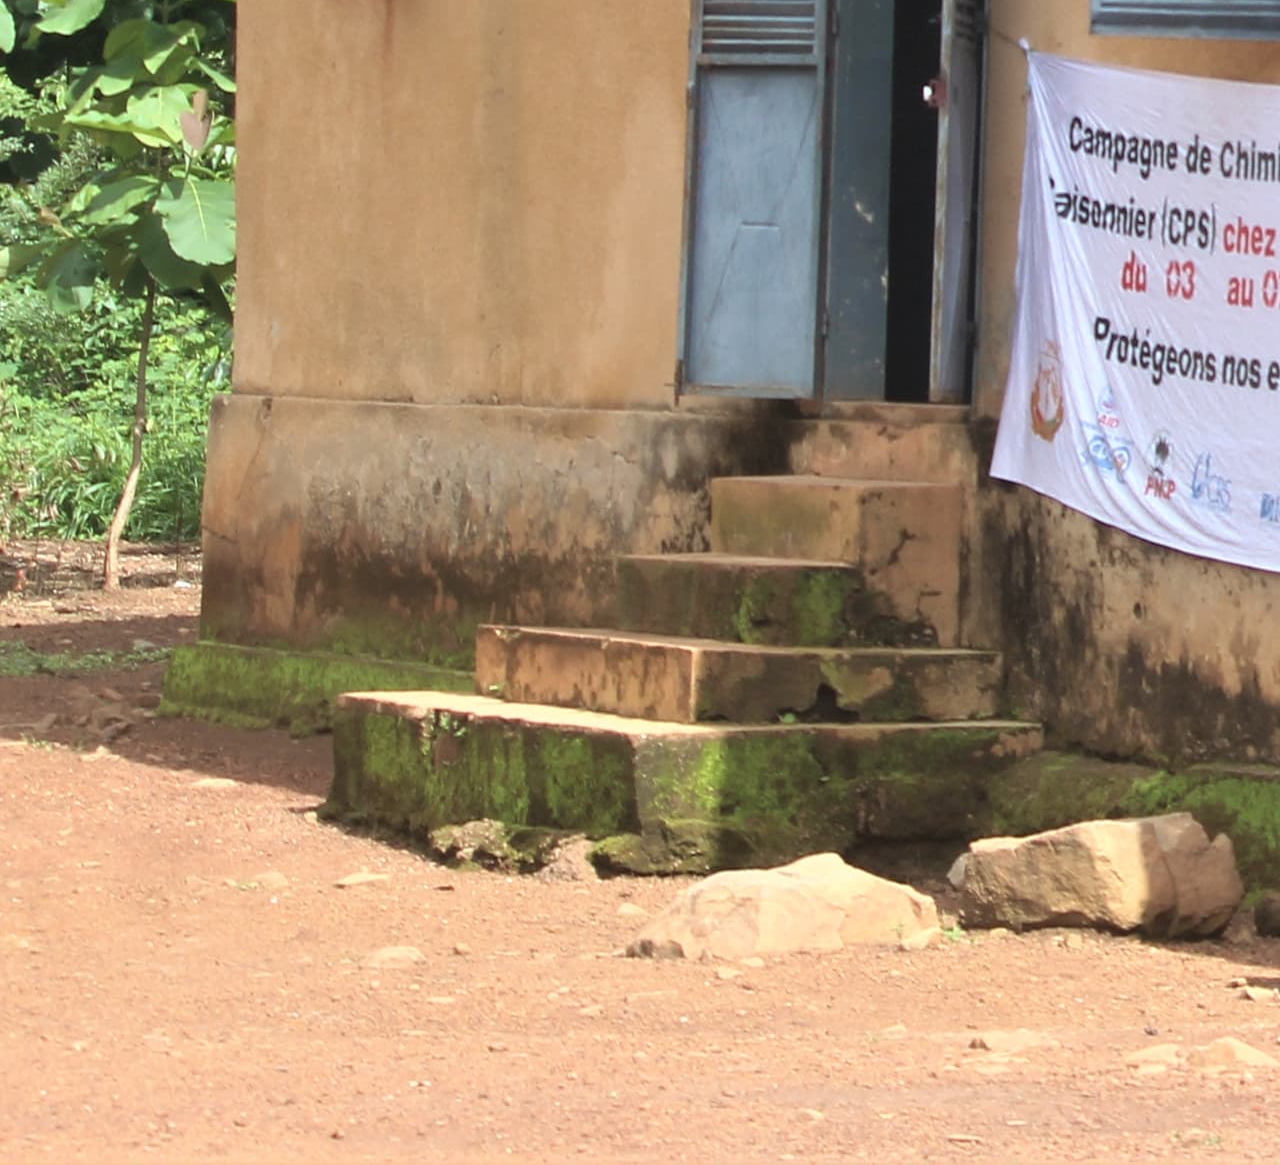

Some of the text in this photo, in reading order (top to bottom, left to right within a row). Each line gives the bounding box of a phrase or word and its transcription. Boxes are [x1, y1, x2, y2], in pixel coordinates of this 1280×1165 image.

[1069, 117, 1178, 180] Campagne
[1186, 134, 1211, 174] de
[1048, 178, 1156, 240] aisonnier
[1161, 197, 1216, 254] (CPS)
[1223, 217, 1275, 257] chez
[1121, 250, 1147, 293] du
[1166, 260, 1196, 300] 03
[1227, 276, 1253, 308] au
[1094, 317, 1216, 386] Protégeons
[1222, 354, 1261, 389] nos
